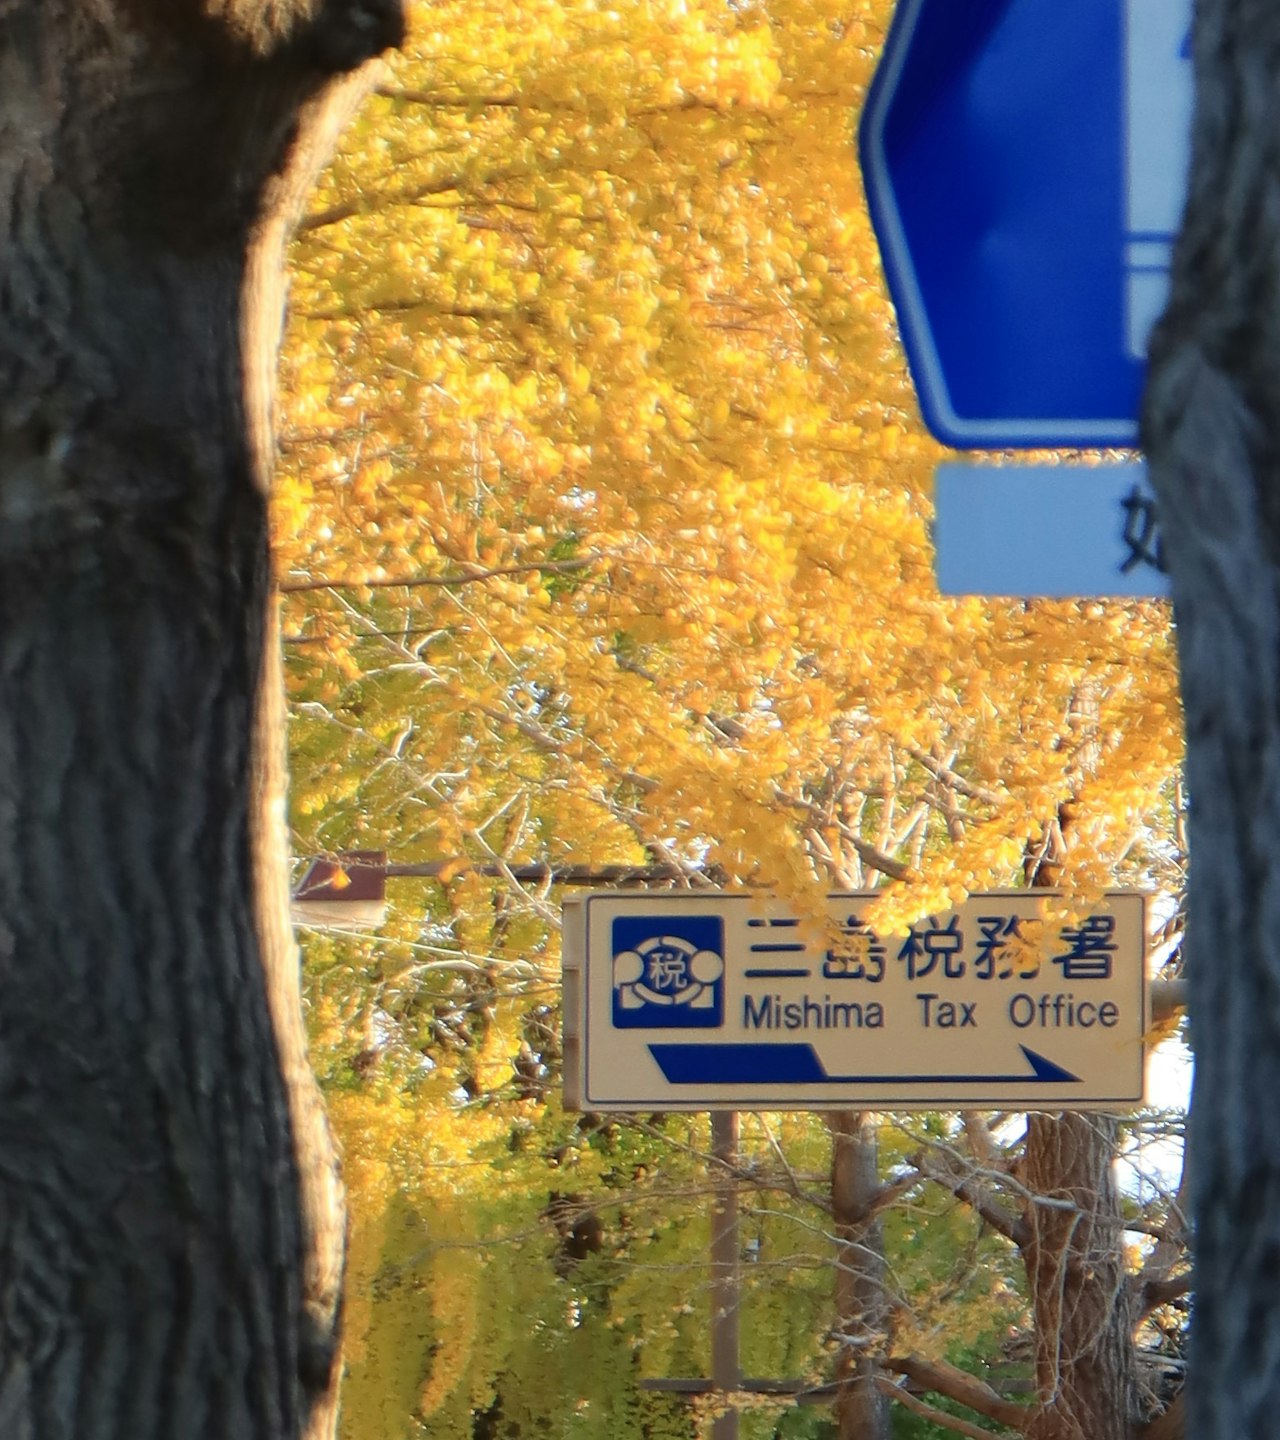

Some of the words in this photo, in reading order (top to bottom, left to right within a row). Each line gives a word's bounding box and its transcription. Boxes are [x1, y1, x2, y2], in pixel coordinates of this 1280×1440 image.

[649, 951, 688, 990] 税
[743, 994, 885, 1029] Mishima
[916, 993, 978, 1028] Tax
[1009, 992, 1120, 1028] Office
